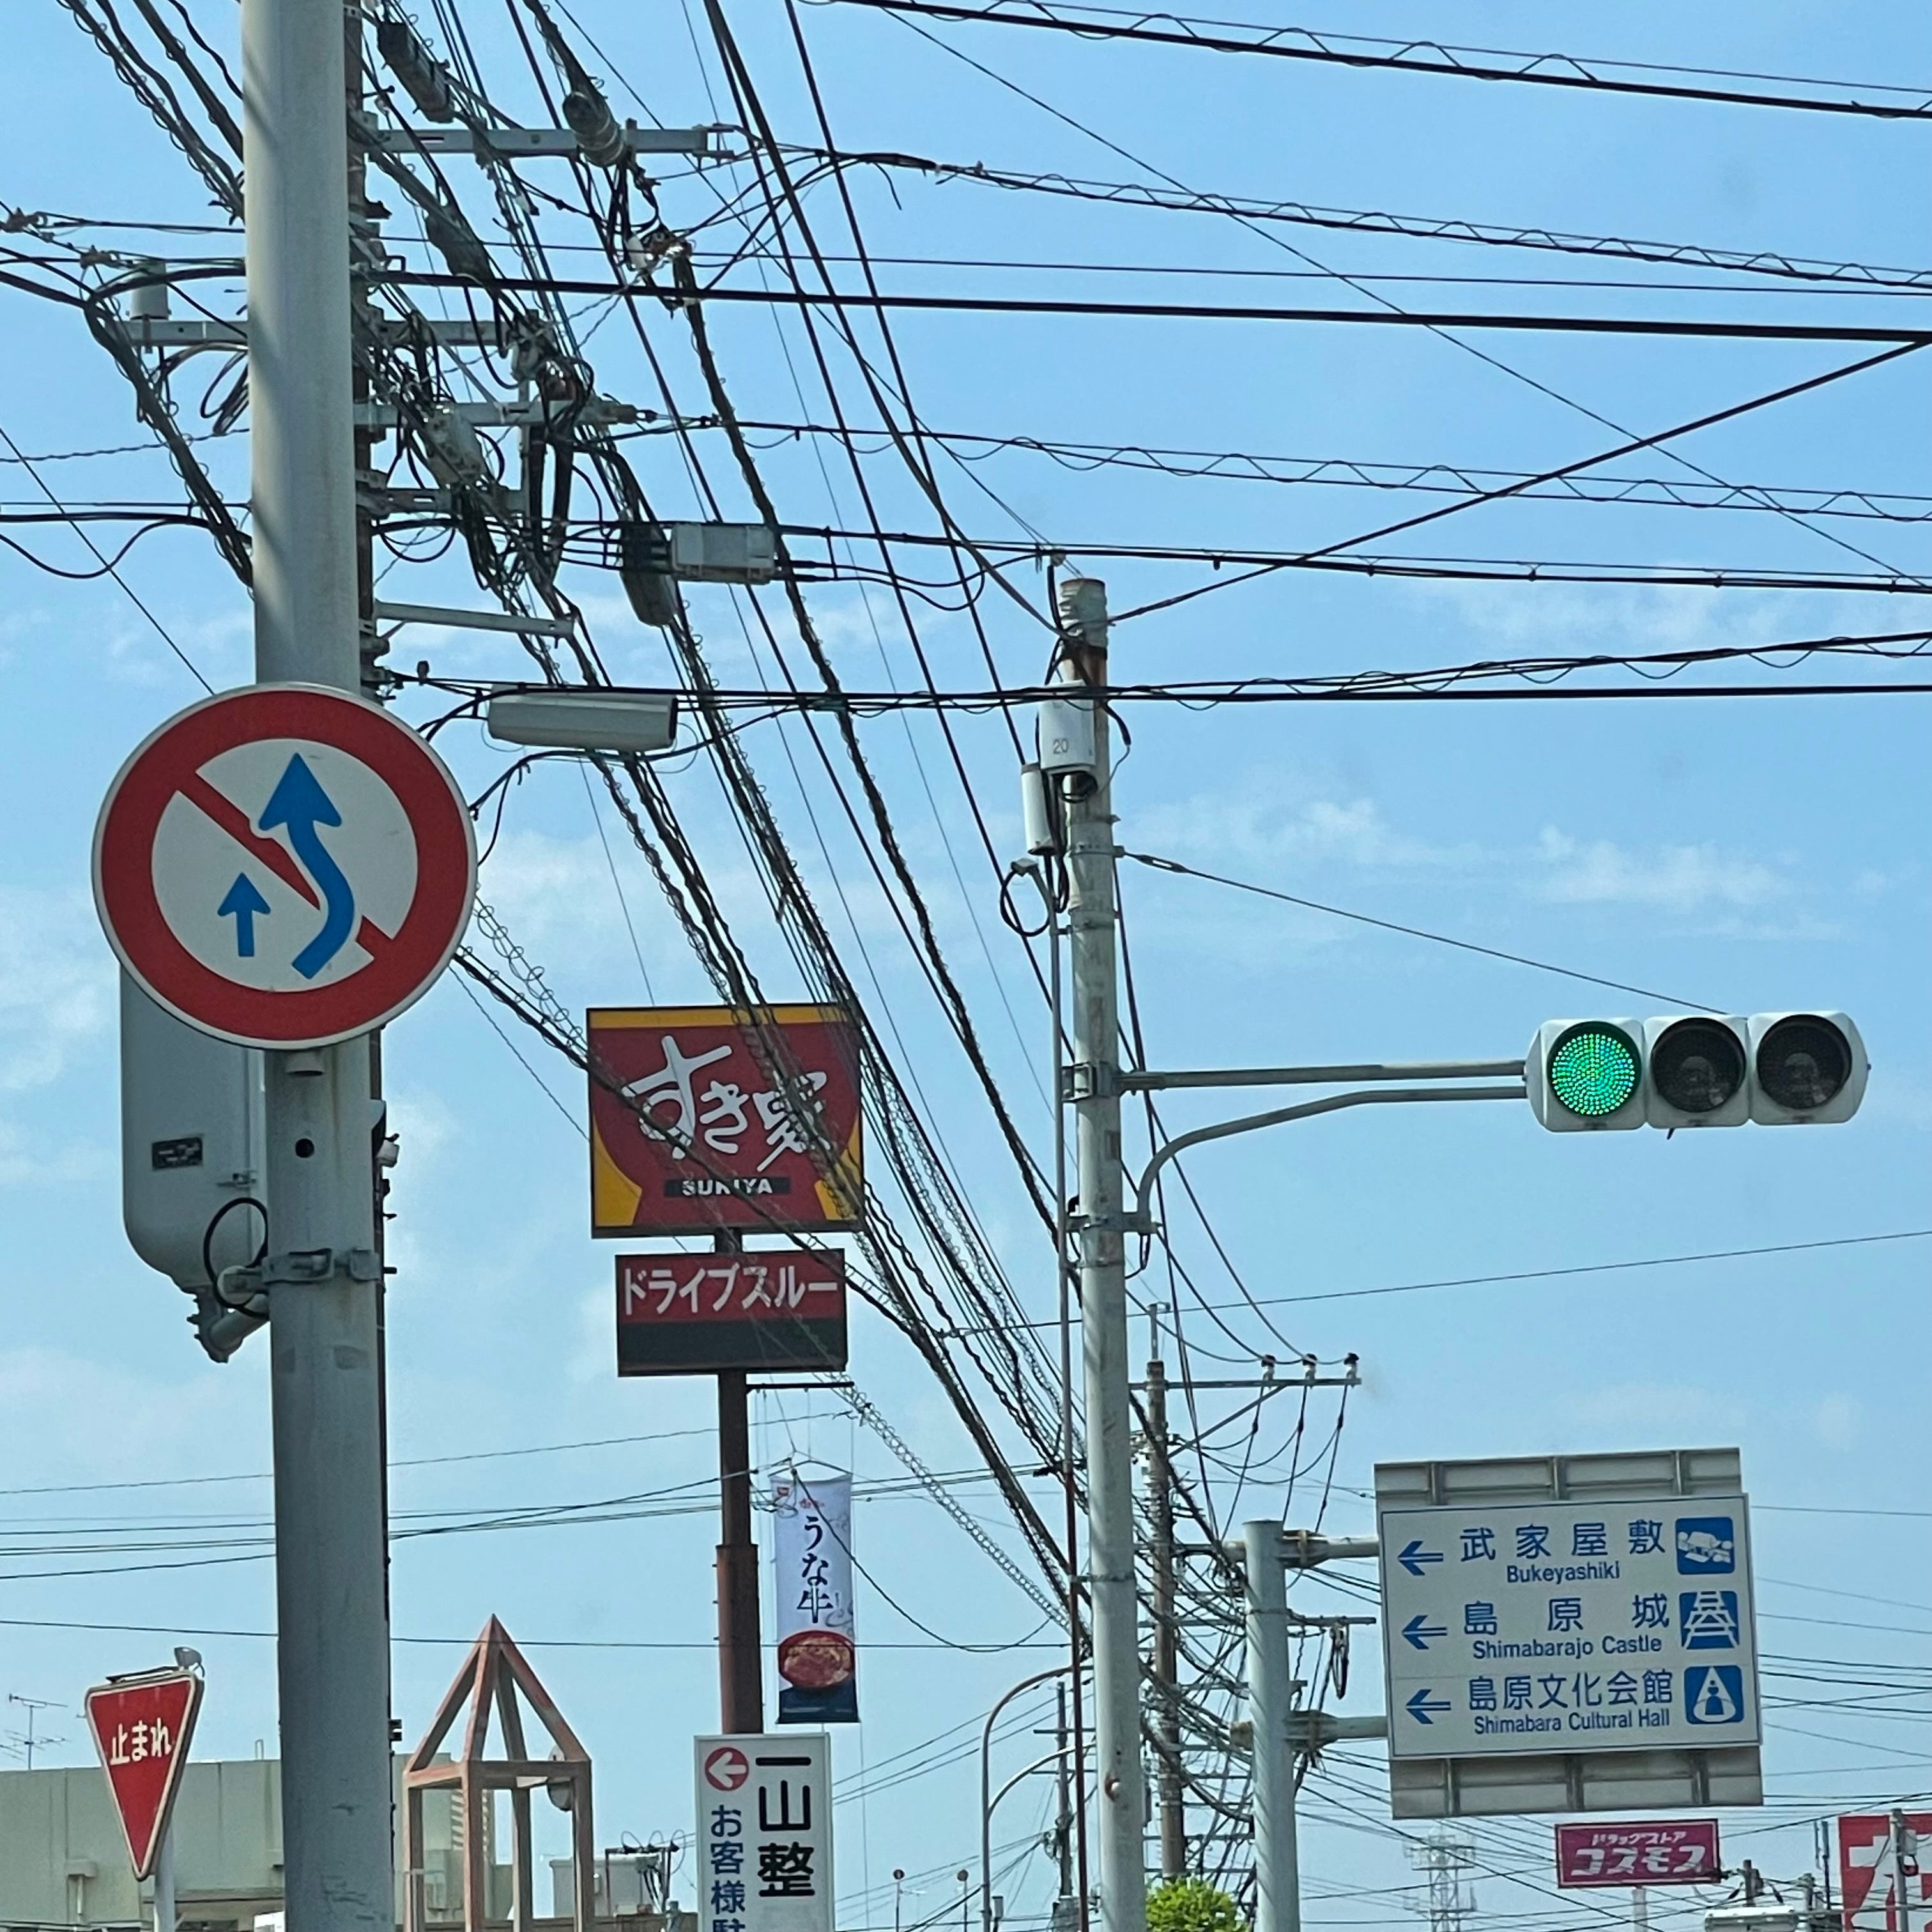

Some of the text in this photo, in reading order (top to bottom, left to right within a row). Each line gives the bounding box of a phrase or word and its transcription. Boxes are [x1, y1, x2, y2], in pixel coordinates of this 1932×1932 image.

[1053, 738, 1069, 754] 20
[1460, 1519, 1666, 1563] 武家屋敷
[797, 1515, 834, 1623] うな牛
[1506, 1560, 1620, 1585] Bukeyashiki
[1463, 1593, 1669, 1636] 島原城
[1472, 1635, 1662, 1660] Shimabarajo Castle
[1468, 1669, 1673, 1712] 島原文化会館
[1474, 1708, 1670, 1735] Shimabara Cultural Hall
[109, 1717, 172, 1765] 止まれ
[1570, 1844, 1706, 1876] コスモス
